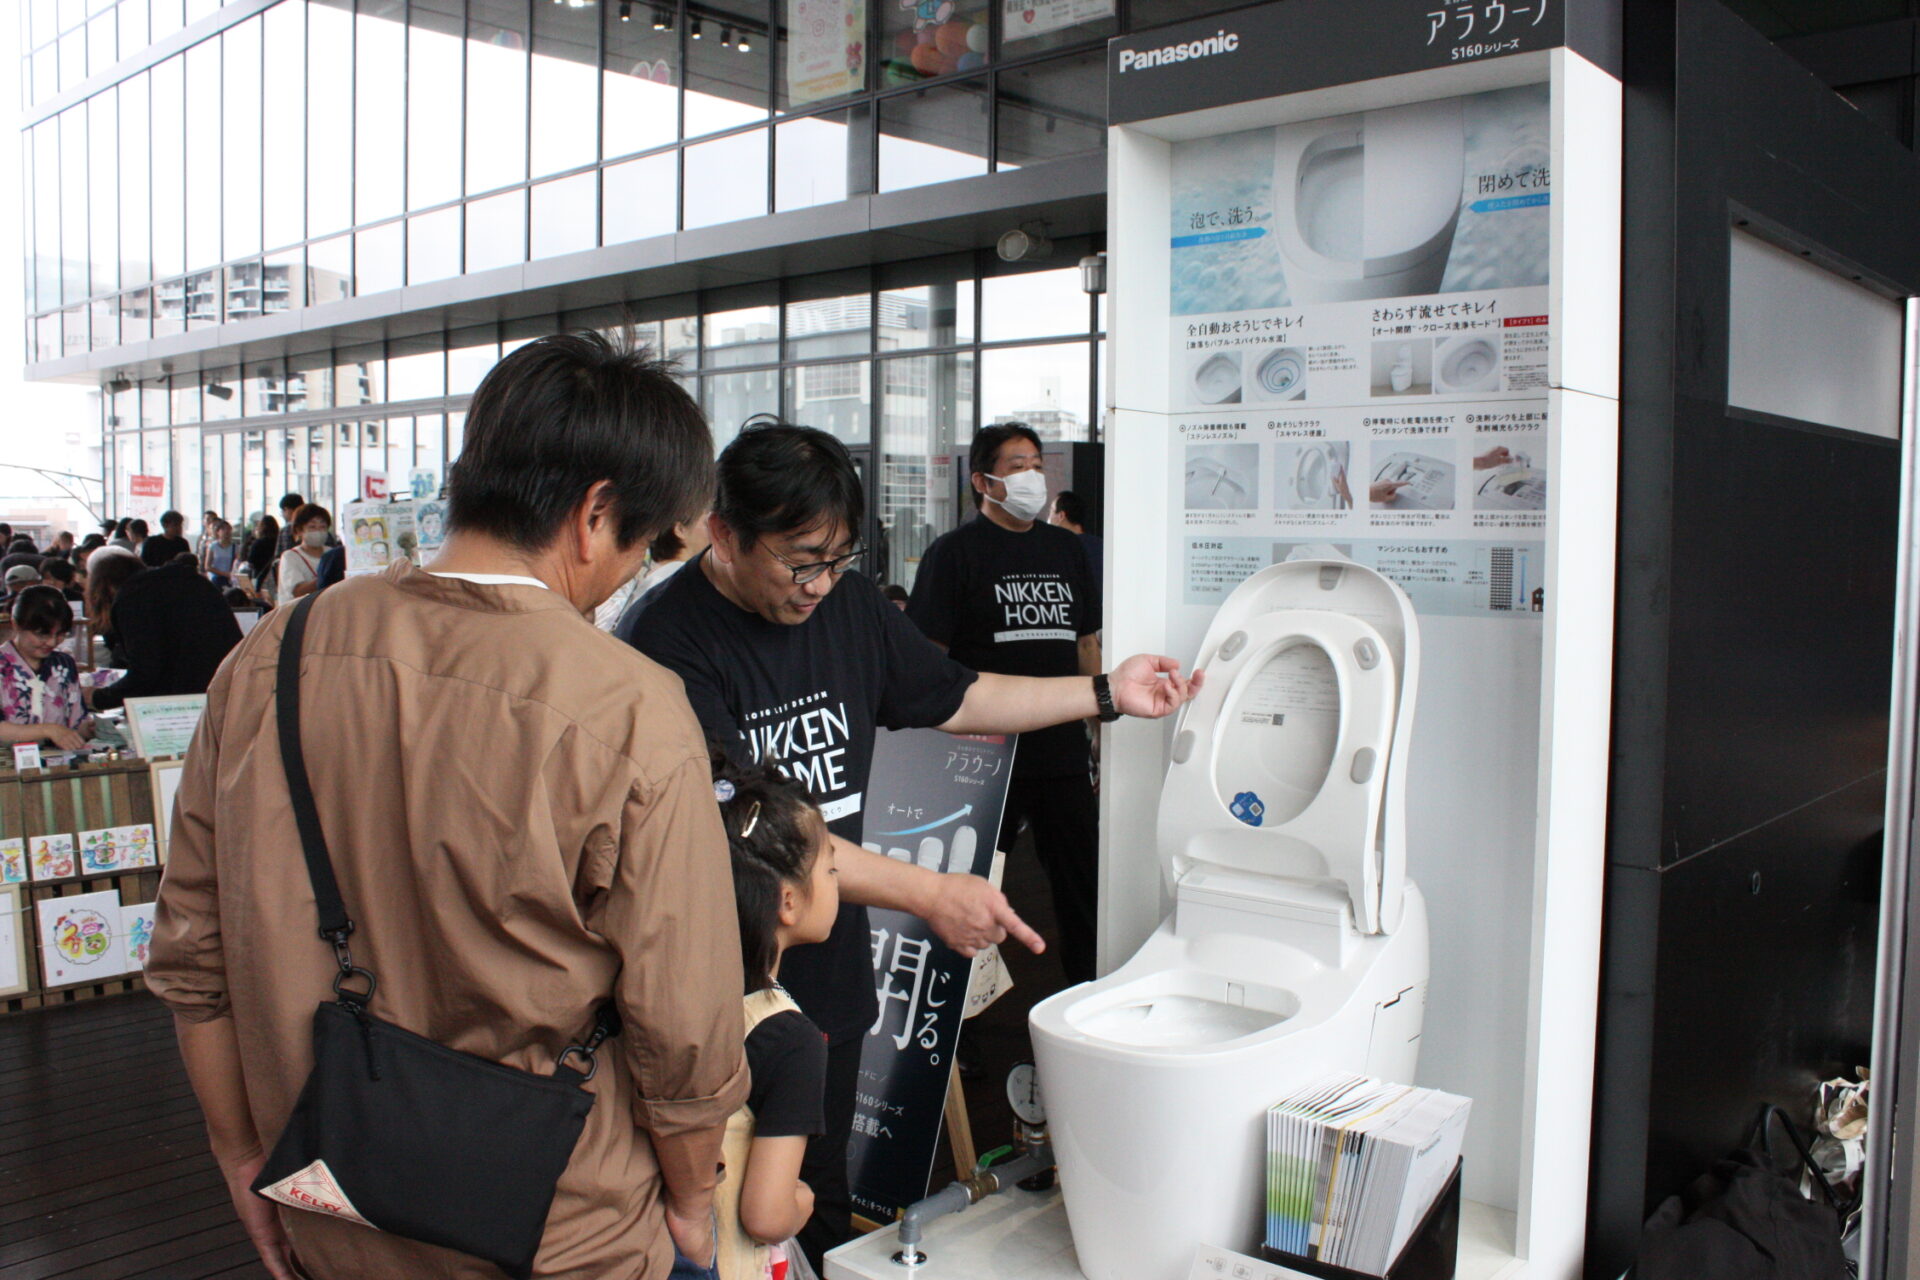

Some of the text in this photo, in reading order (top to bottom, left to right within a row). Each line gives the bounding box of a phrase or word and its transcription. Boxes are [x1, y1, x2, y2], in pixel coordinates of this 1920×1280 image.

[1427, 0, 1547, 46] アラウーノ
[1119, 29, 1239, 73] Panasonic
[1451, 38, 1520, 60] S160シリーズ
[1479, 167, 1550, 194] 閉めて洗
[1372, 300, 1498, 322] さわらず流せてキレイ
[1187, 315, 1304, 337] 全自動おそうじでキレイ
[365, 476, 387, 499] に
[1377, 544, 1449, 554] マンションにもおすすめ
[994, 581, 1074, 604] NIKKEN
[1004, 603, 1072, 627] HOME
[944, 751, 1002, 776] アラウーノ
[888, 802, 924, 820] オートで
[289, 1187, 343, 1212] KELTY
